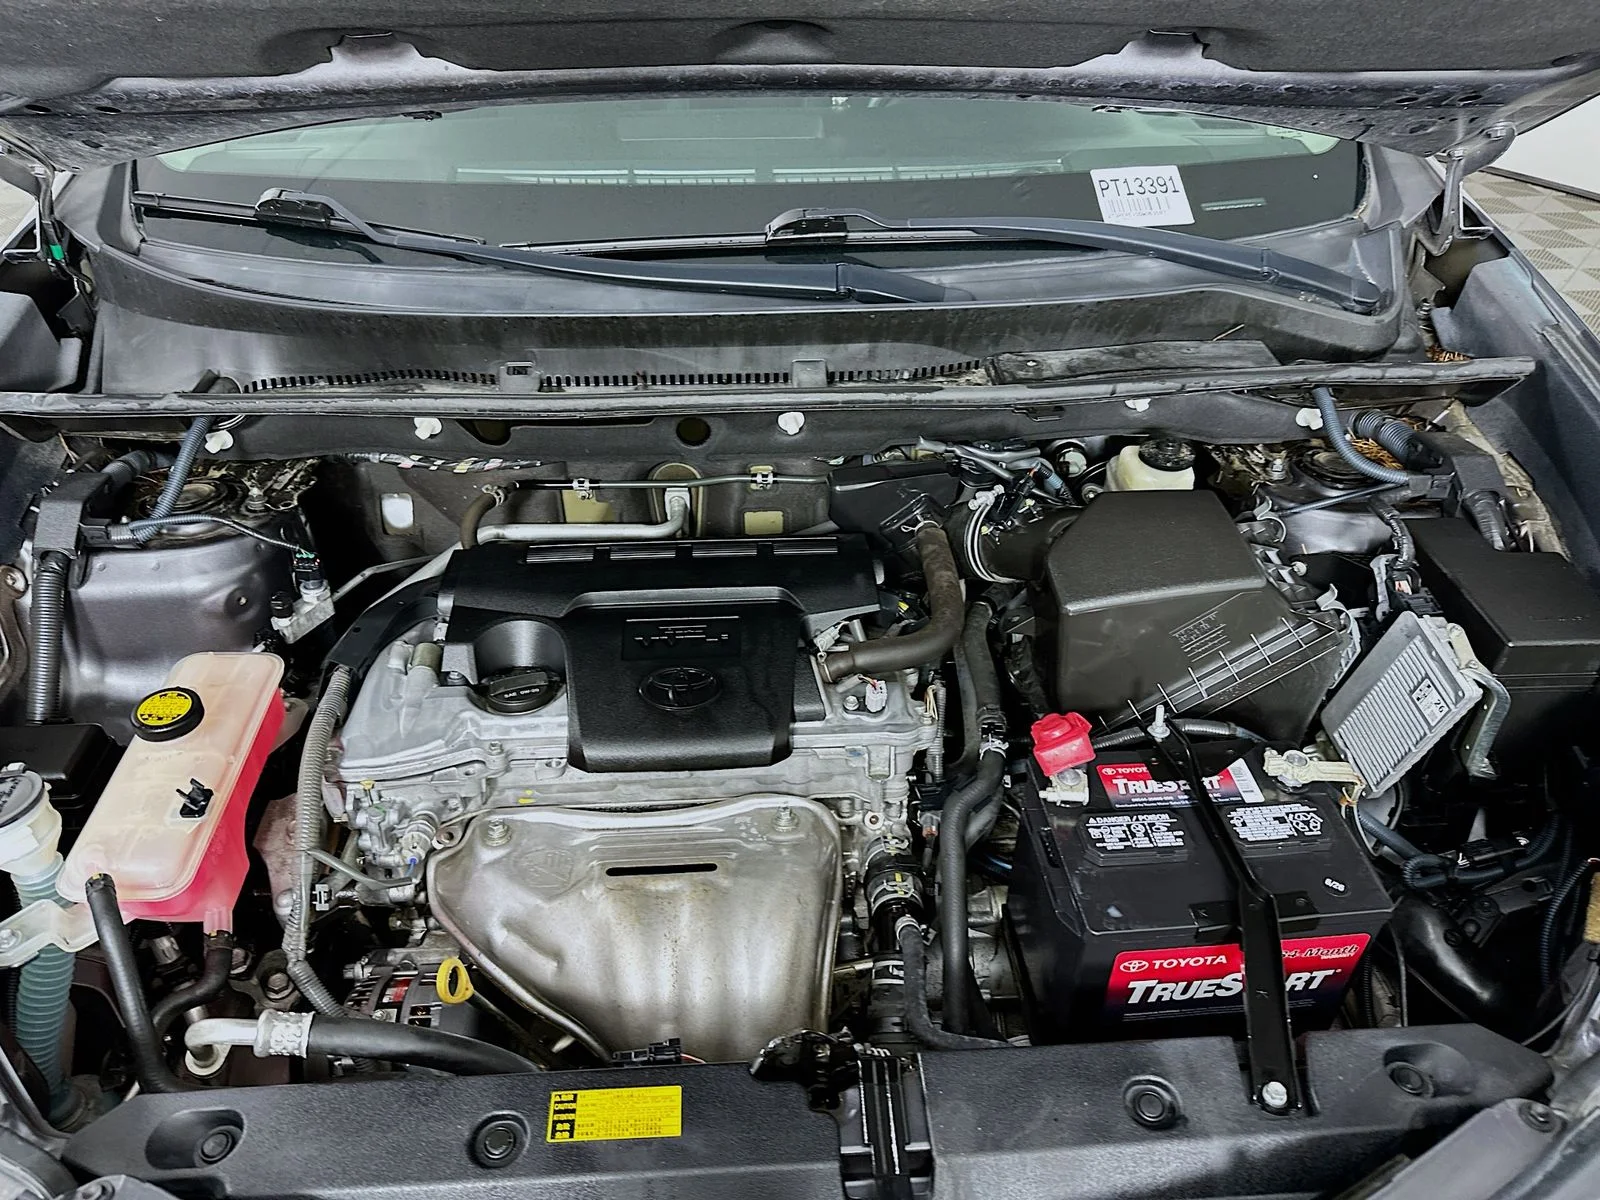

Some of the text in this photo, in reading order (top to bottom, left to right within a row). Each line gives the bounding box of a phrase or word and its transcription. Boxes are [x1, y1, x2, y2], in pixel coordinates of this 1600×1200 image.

[1098, 175, 1180, 198] PT13391
[1116, 766, 1150, 774] TOYOT
[1095, 815, 1132, 824] DANGER
[1137, 813, 1170, 822] POISON
[1153, 955, 1228, 970] TOYOTA
[1127, 969, 1336, 1004] TRUESRT
